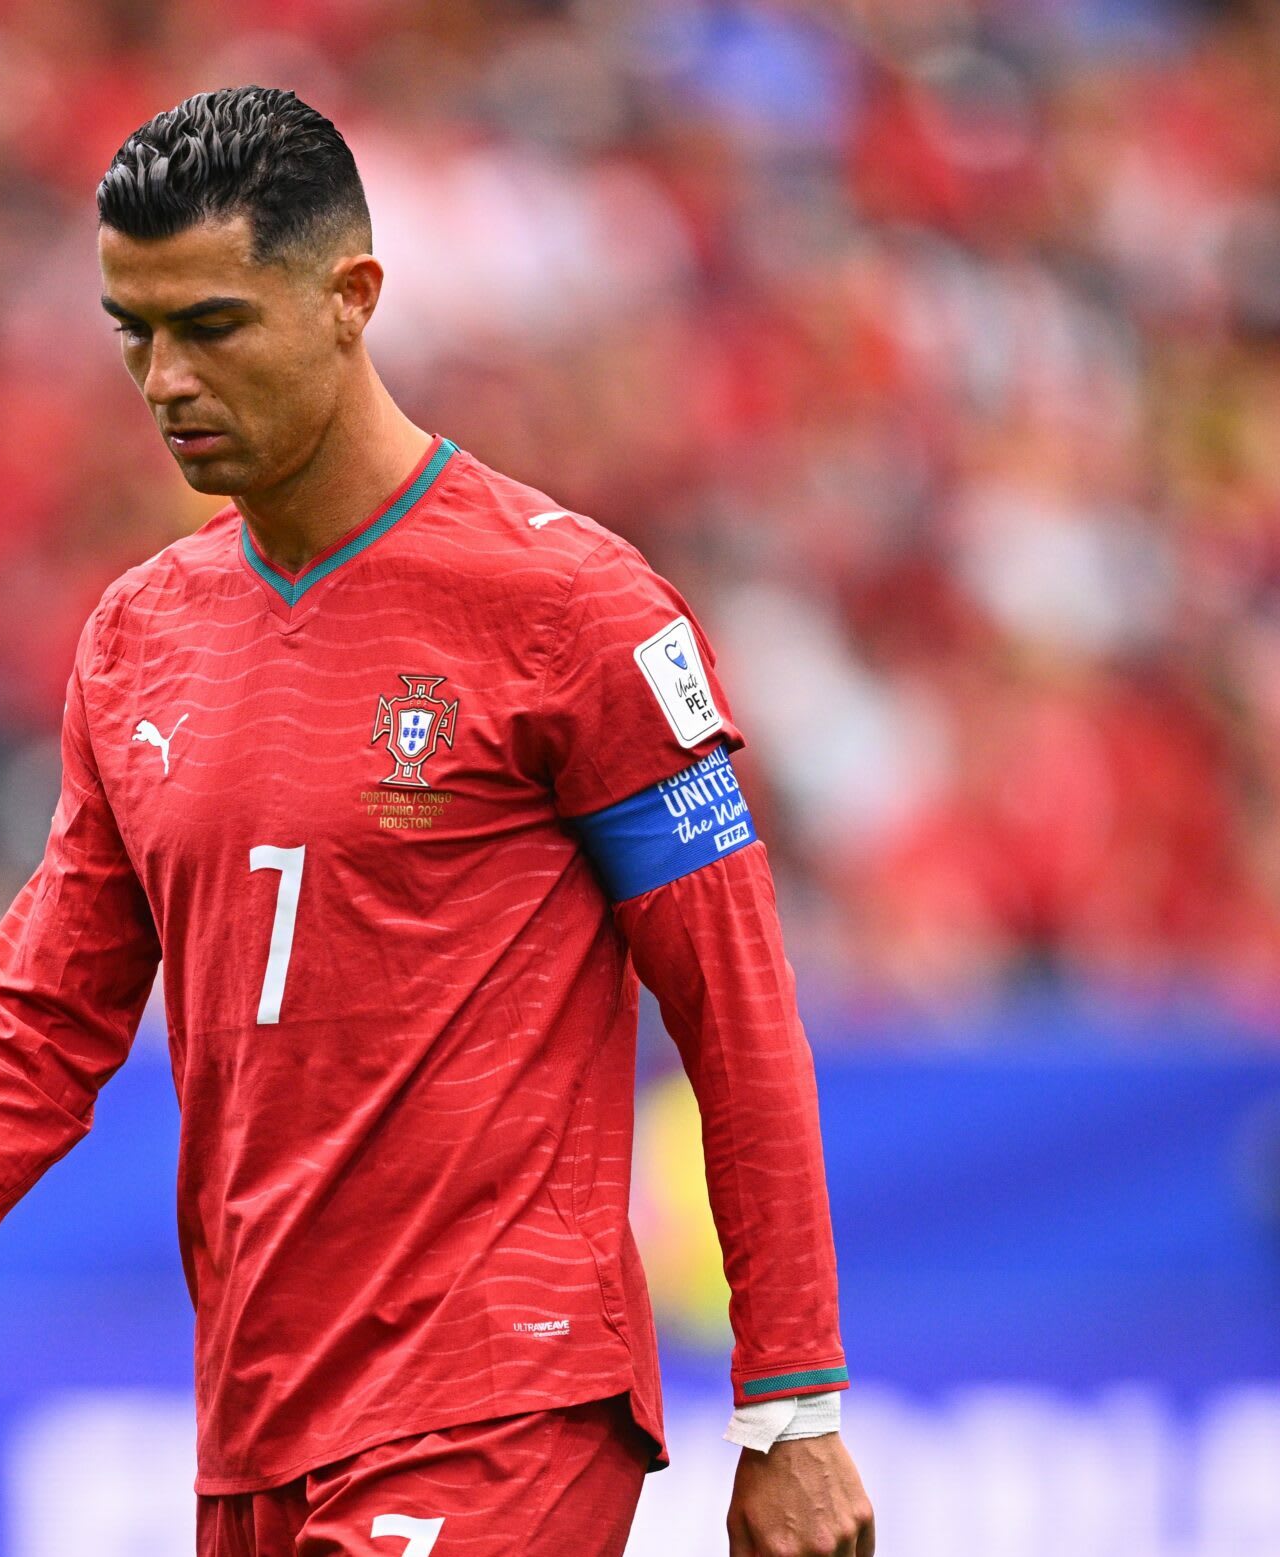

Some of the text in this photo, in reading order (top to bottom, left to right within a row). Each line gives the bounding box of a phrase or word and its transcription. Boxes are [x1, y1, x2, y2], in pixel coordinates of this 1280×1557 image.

[360, 791, 452, 805] PORTUGAL/CONGO
[663, 764, 739, 818] UNITES
[367, 805, 444, 816] 17 JUNHO 2026
[379, 817, 432, 829] HOUSTON
[672, 816, 713, 844] the
[718, 826, 747, 847] FIFA
[249, 843, 306, 1025] 7
[513, 1319, 570, 1332] ULTRAWEAVE
